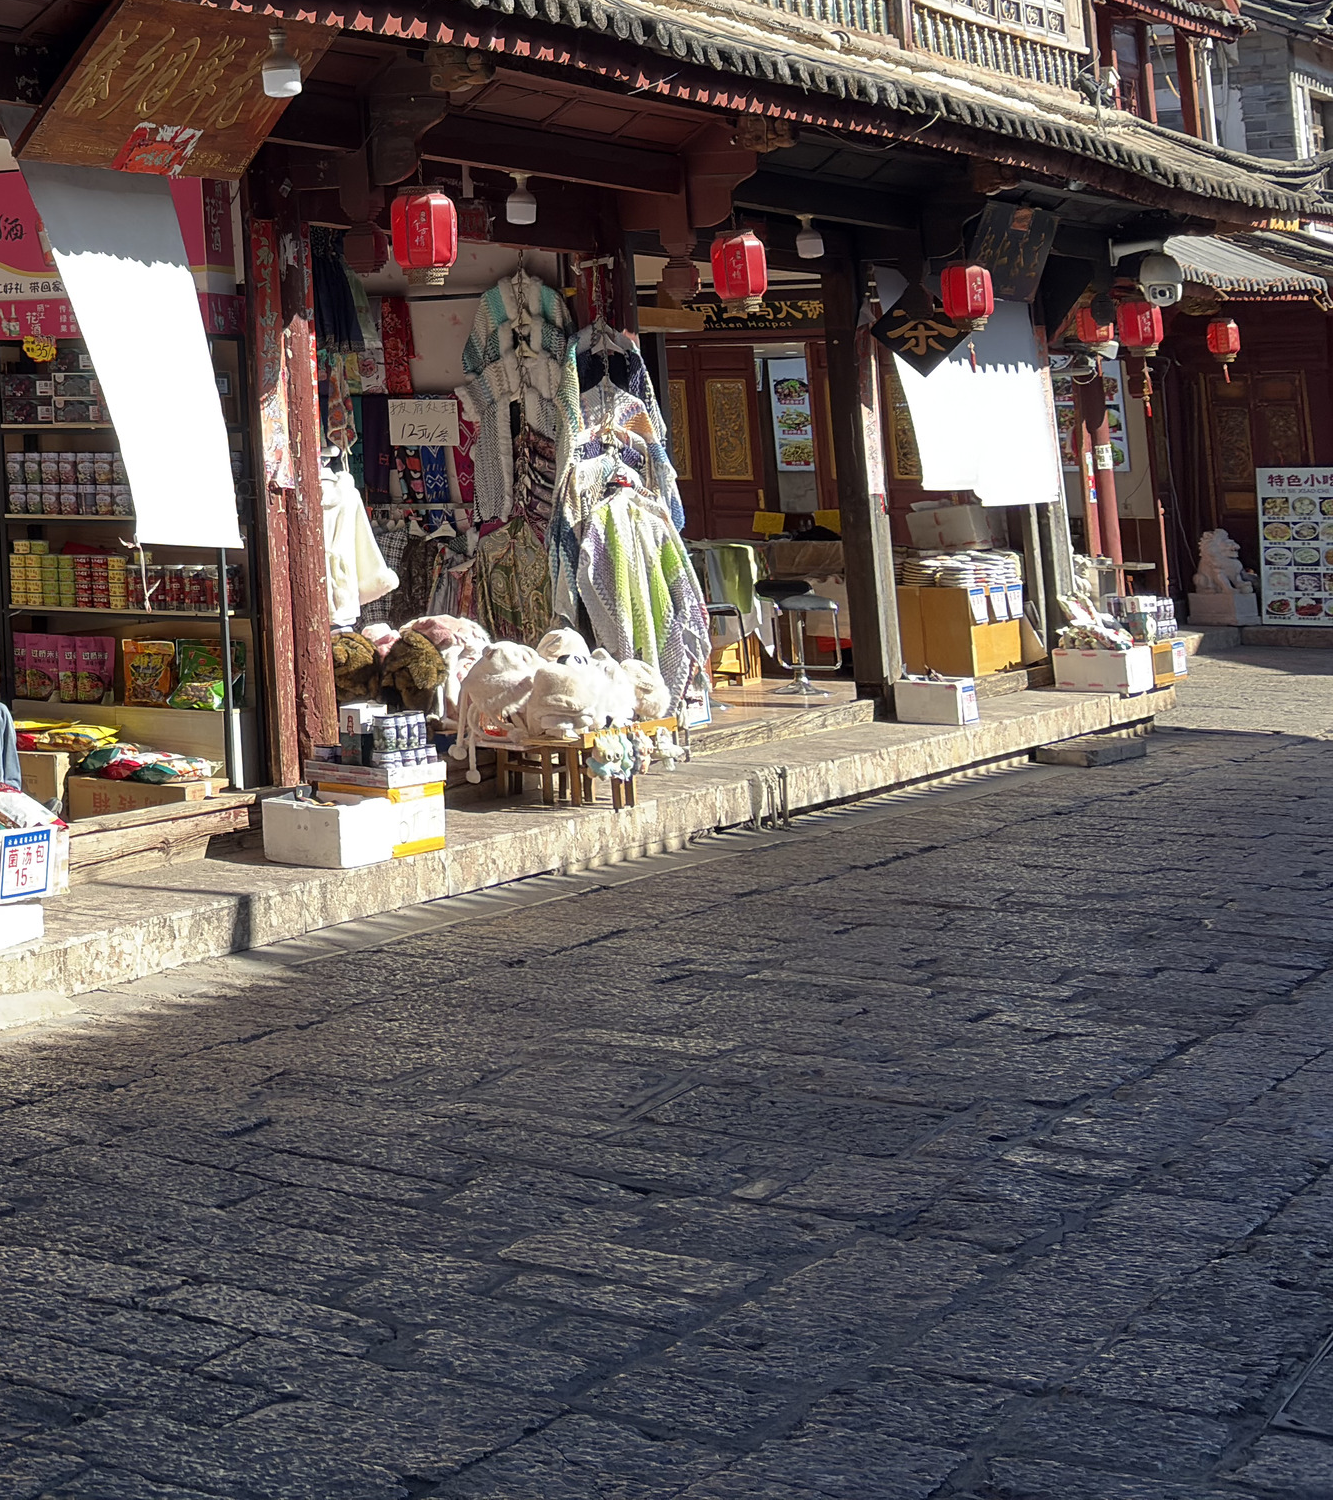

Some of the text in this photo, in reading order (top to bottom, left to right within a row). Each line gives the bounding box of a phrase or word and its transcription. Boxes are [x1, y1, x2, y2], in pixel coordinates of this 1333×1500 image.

[29, 280, 64, 294] 带回家
[747, 320, 793, 329] Hotpot
[886, 308, 959, 355] 茶
[390, 401, 456, 415] 披肩处理
[8, 845, 44, 868] 菌汤包
[15, 867, 27, 886] 15
